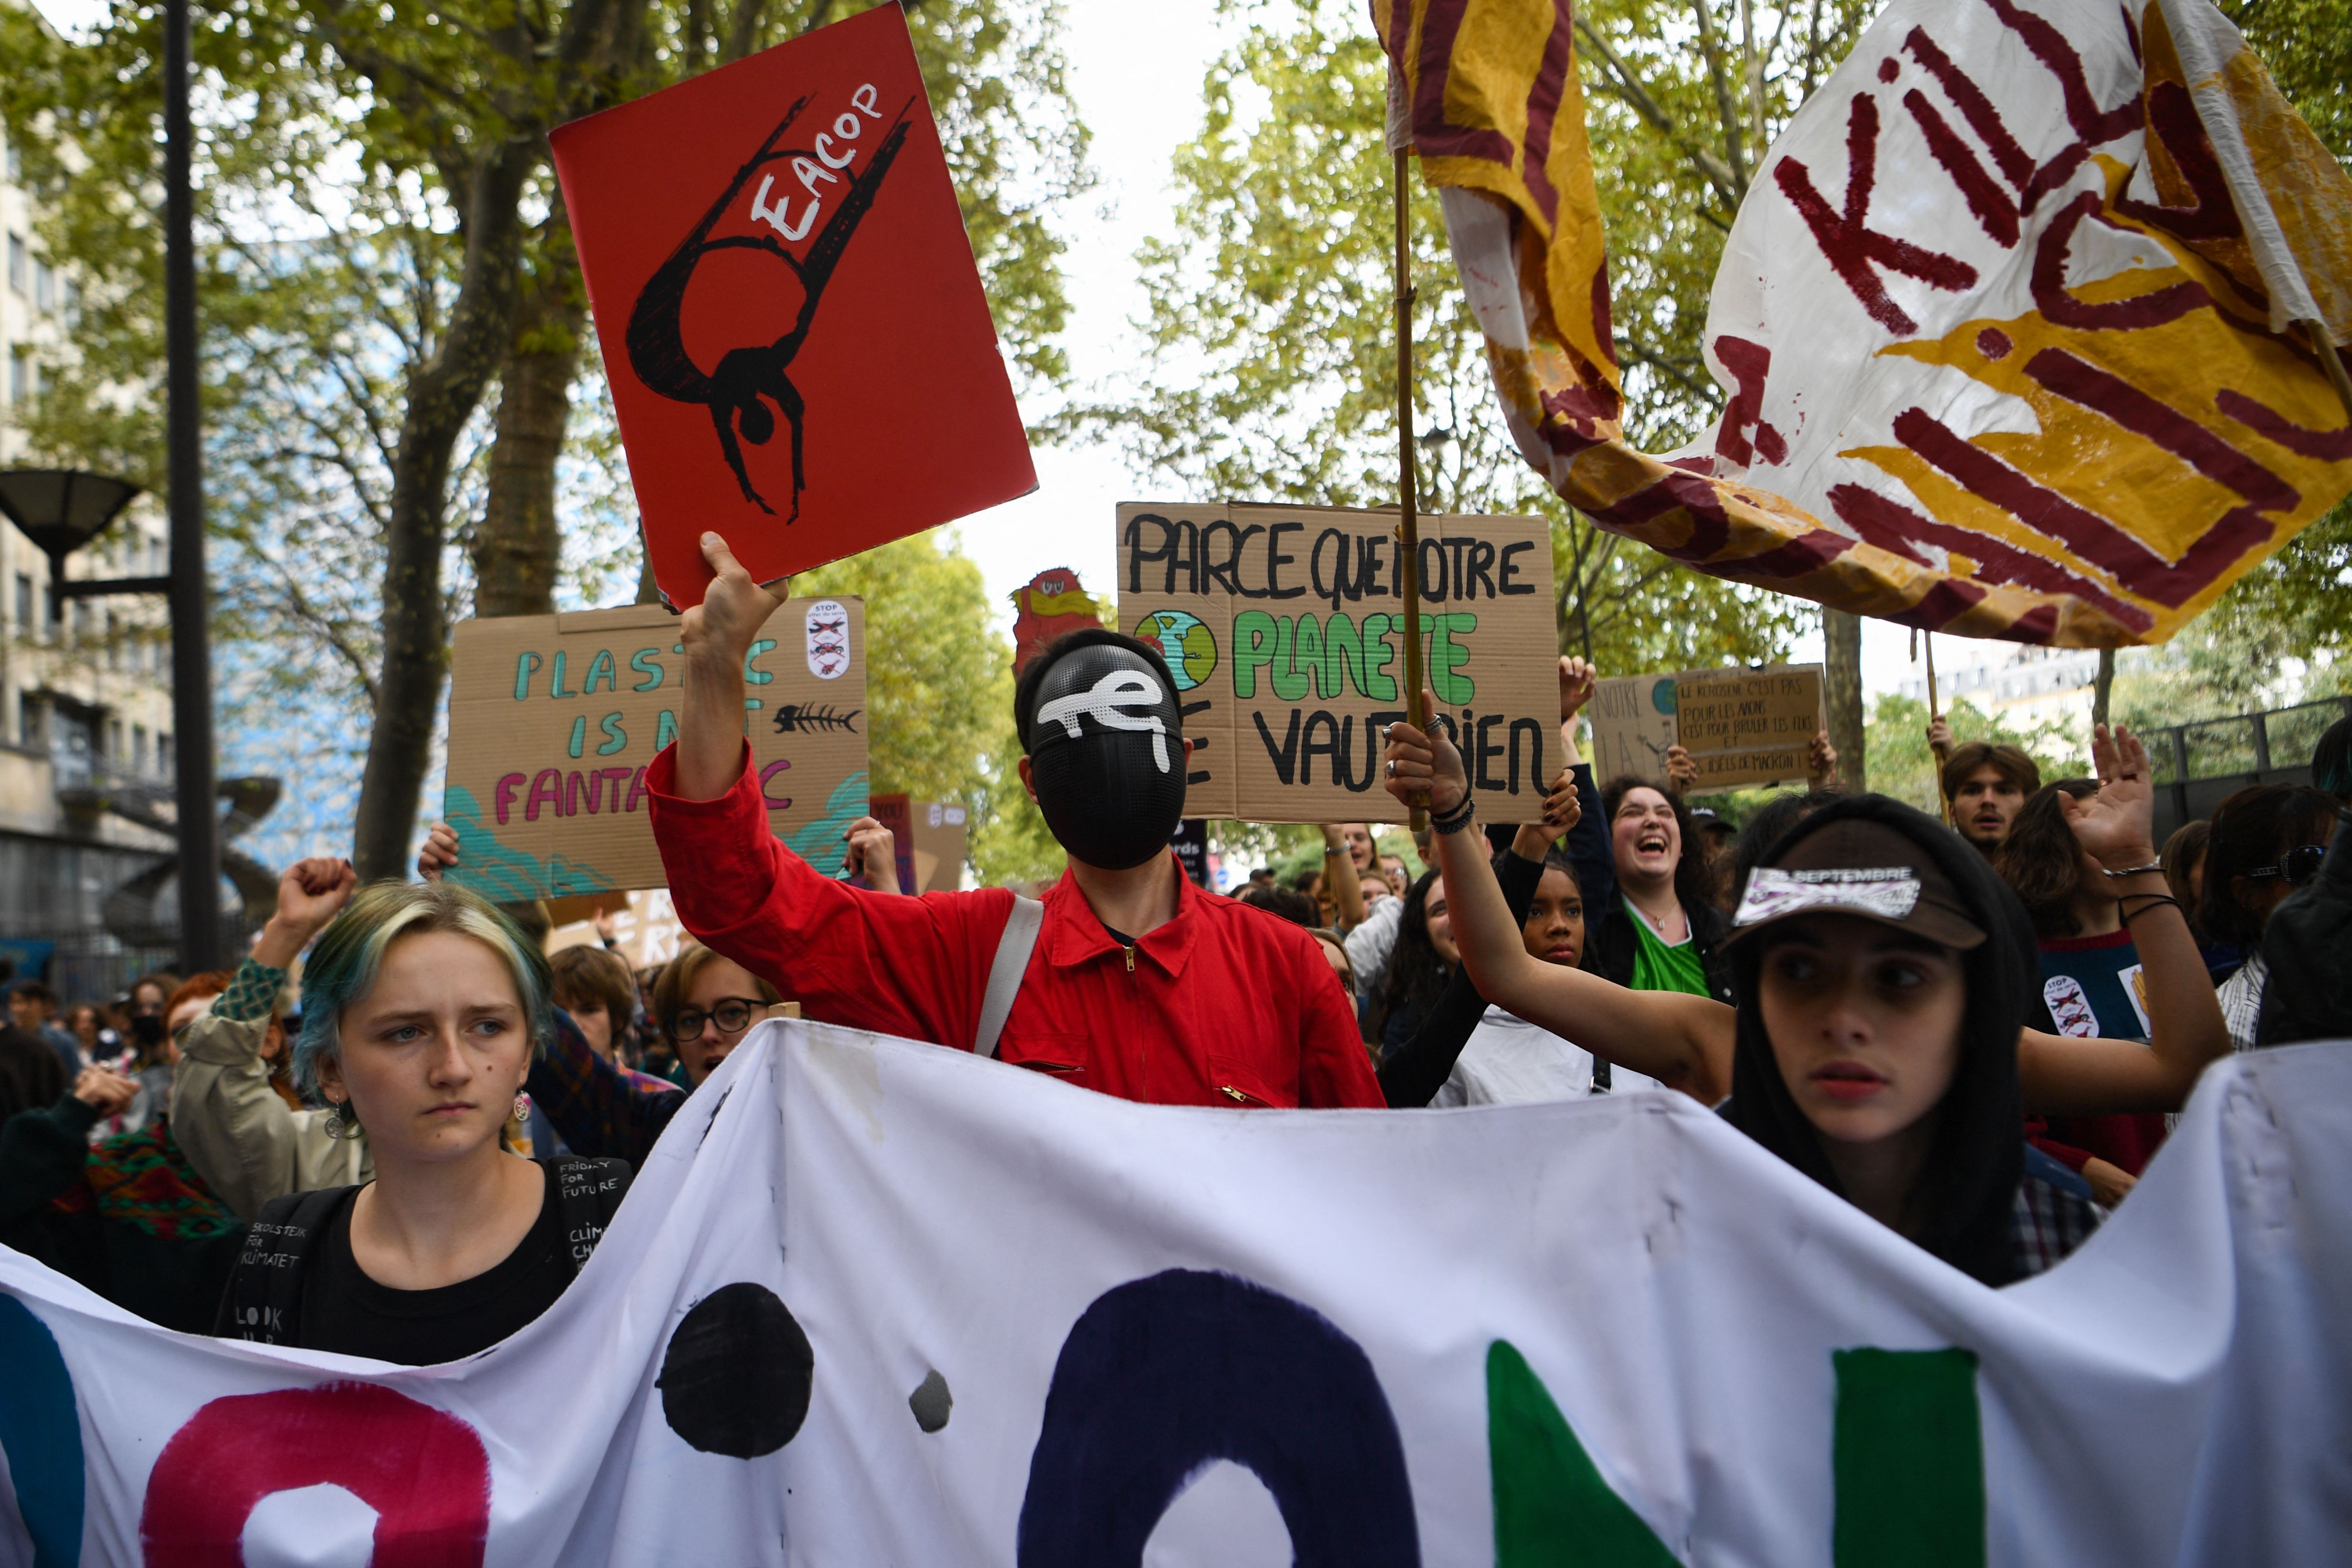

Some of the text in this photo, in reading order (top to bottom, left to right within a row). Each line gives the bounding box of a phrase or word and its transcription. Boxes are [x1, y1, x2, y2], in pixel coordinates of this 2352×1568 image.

[751, 83, 883, 241] EACOP
[1124, 513, 1307, 599] PARCE
[1311, 527, 1389, 611] QUE
[515, 639, 778, 701] PLASC
[1233, 610, 1477, 706] PLANETE
[1781, 677, 1802, 695] PAS
[1683, 705, 1716, 723] POUR
[569, 711, 628, 758] IS
[1707, 721, 1730, 737] POUR
[1723, 735, 1739, 748] ET
[496, 759, 792, 825] FANTAC
[1791, 866, 1912, 883] SEPTEMBRE
[561, 1174, 585, 1184] FOR
[562, 1177, 619, 1199] FUTURE
[236, 1306, 282, 1332] LOOK
